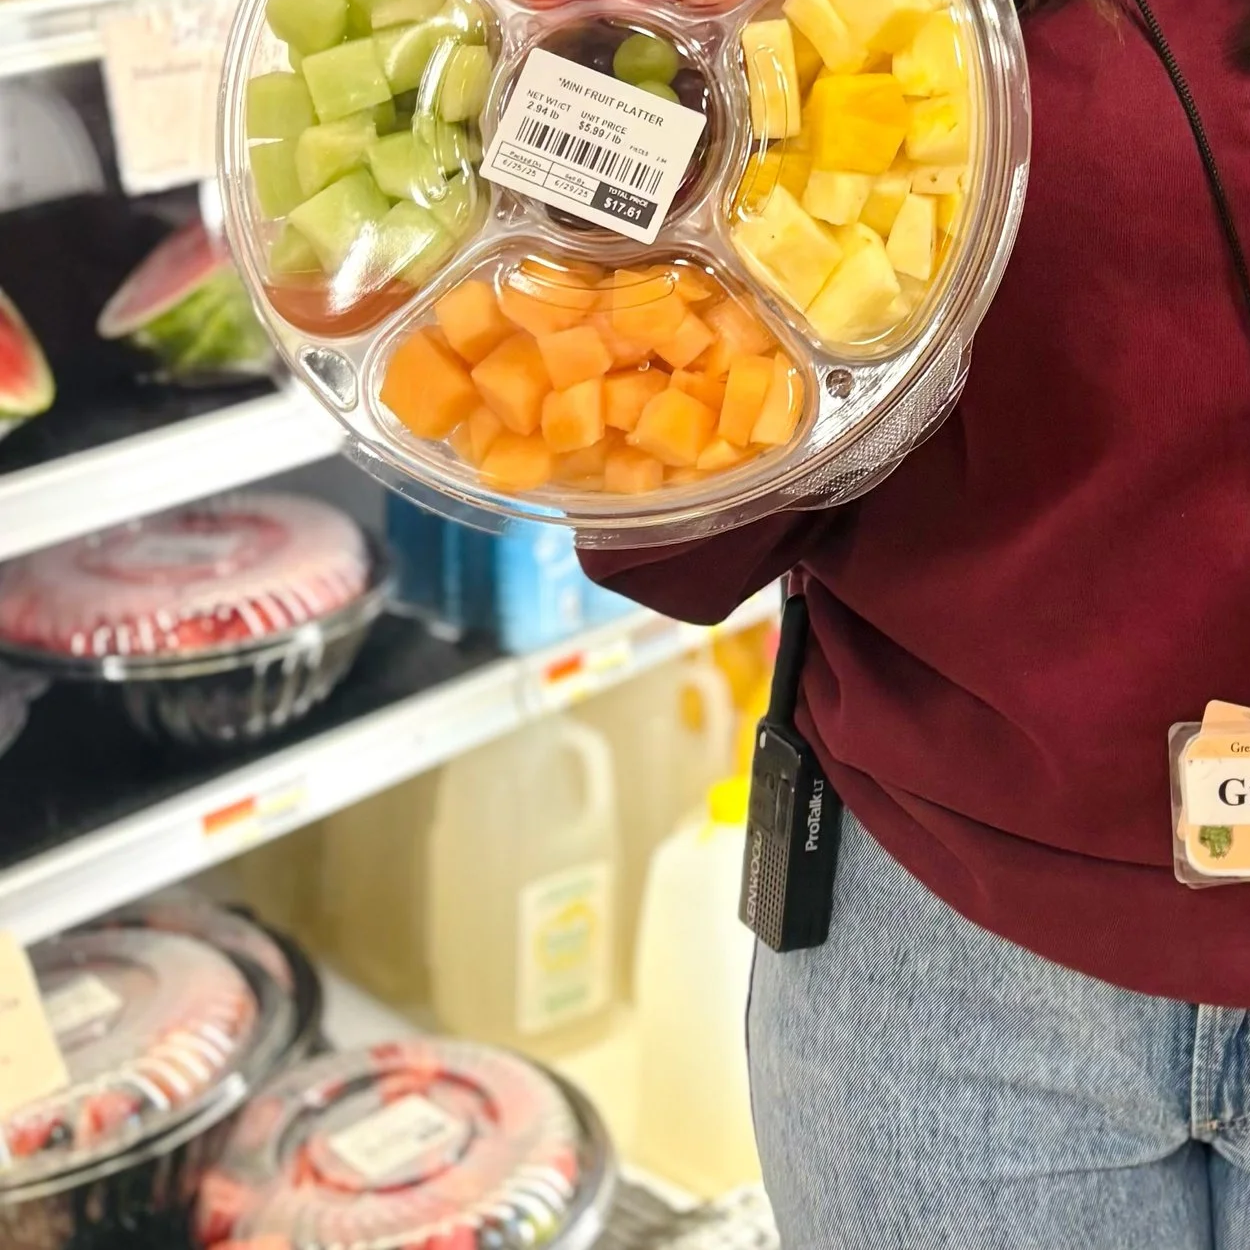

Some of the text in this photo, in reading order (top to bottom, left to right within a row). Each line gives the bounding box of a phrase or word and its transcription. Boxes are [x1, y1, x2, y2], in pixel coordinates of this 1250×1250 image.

[526, 89, 571, 112] NET WT/CT
[526, 100, 560, 120] 2.94 lb
[583, 88, 615, 107] FRUIT
[615, 100, 664, 127] PLATTER
[577, 120, 605, 138] $5.99
[611, 134, 622, 145] lb
[580, 110, 627, 134] UNIT PRICE
[602, 196, 642, 221] $17.61
[607, 186, 648, 208] TOTAL PRICE
[805, 778, 824, 852] ProTalk LT
[746, 830, 764, 927] KENWOOD
